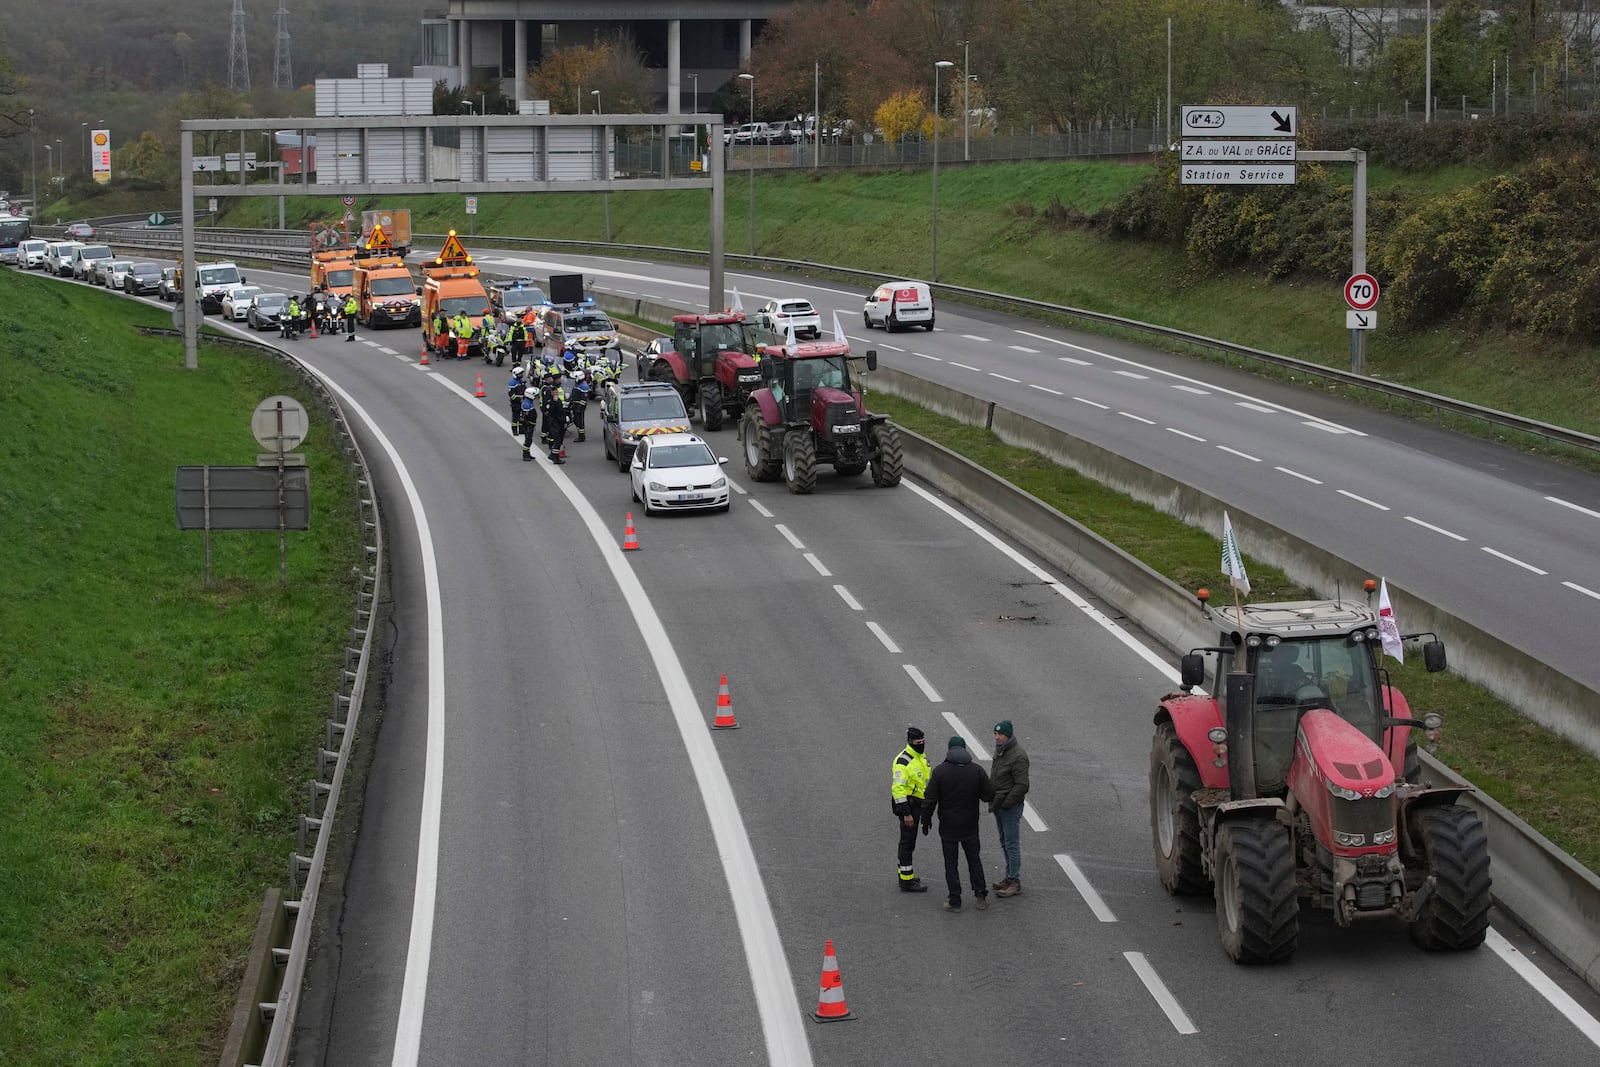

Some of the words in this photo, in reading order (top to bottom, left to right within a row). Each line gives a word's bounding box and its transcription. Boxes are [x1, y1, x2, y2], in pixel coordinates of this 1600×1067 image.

[1204, 114, 1221, 125] 4.2
[1208, 148, 1219, 156] DU
[1222, 145, 1242, 156] VAL
[1245, 148, 1254, 156] DE
[1257, 143, 1293, 156] GRÂCE
[1186, 169, 1230, 180] Station
[1240, 169, 1285, 180] Service
[1353, 285, 1371, 299] 70
